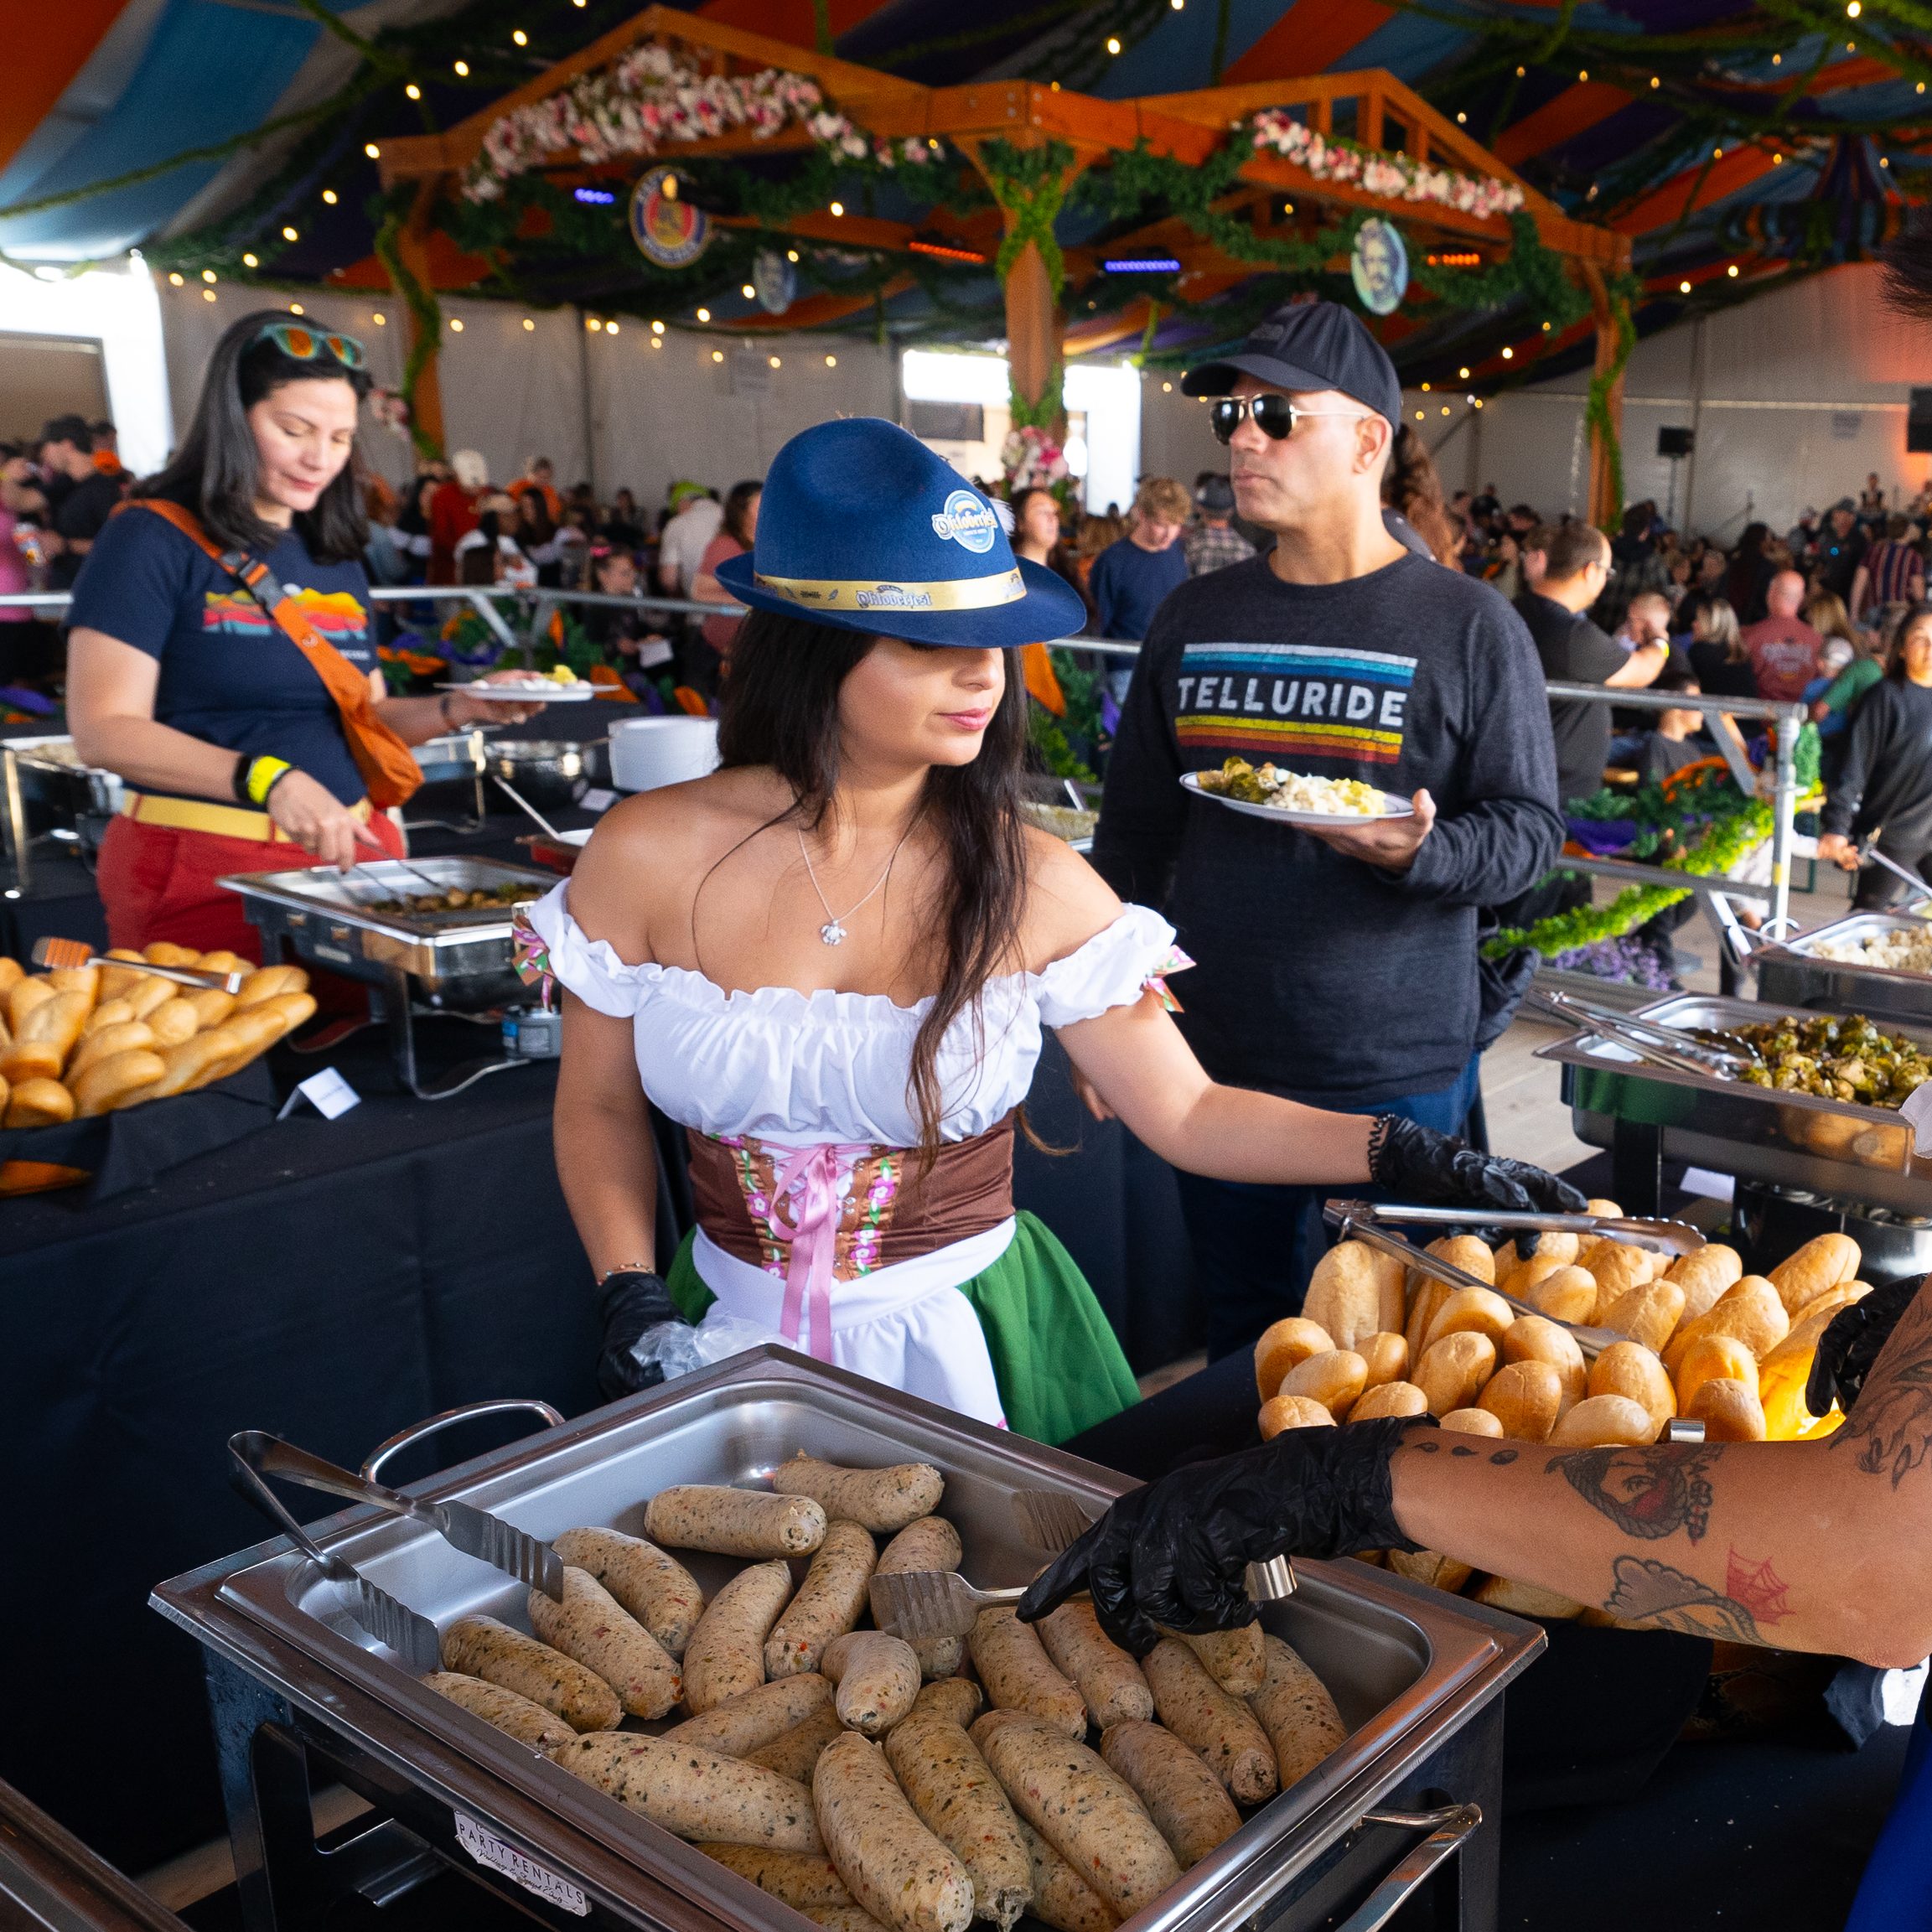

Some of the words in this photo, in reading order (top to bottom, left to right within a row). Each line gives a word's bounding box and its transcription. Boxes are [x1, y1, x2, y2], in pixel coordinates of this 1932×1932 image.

[856, 588, 933, 609] Oktoberfest
[1178, 676, 1408, 728] TELLURIDE
[459, 1823, 505, 1859] PARTY
[512, 1853, 583, 1905] RENTALS
